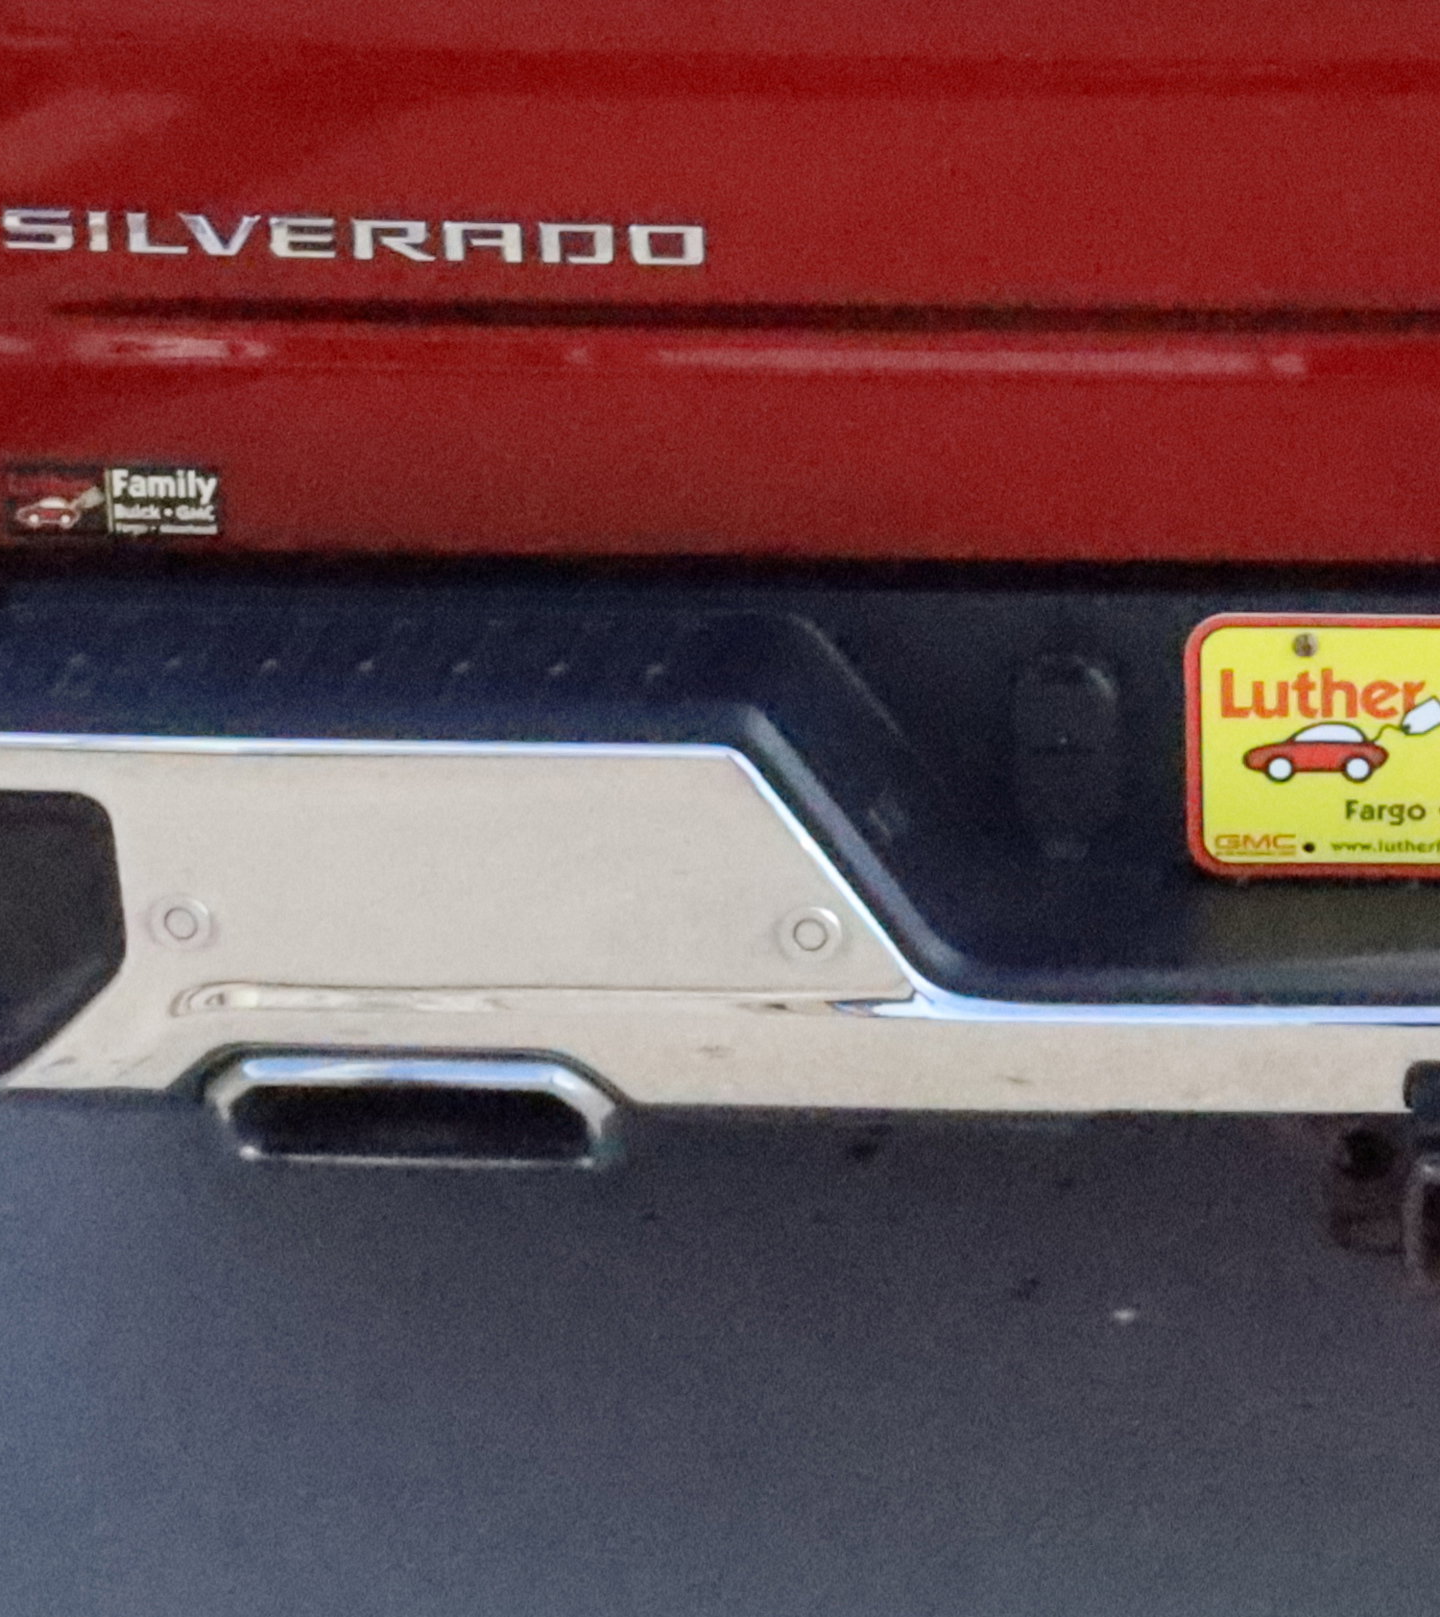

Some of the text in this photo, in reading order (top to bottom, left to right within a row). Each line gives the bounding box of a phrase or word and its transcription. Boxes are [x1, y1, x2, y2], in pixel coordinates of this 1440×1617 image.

[2, 208, 707, 266] SILVERADO
[111, 468, 218, 505] Family
[1220, 668, 1426, 719] Luther
[1345, 799, 1426, 826] Fargo
[1214, 834, 1297, 850] GMC
